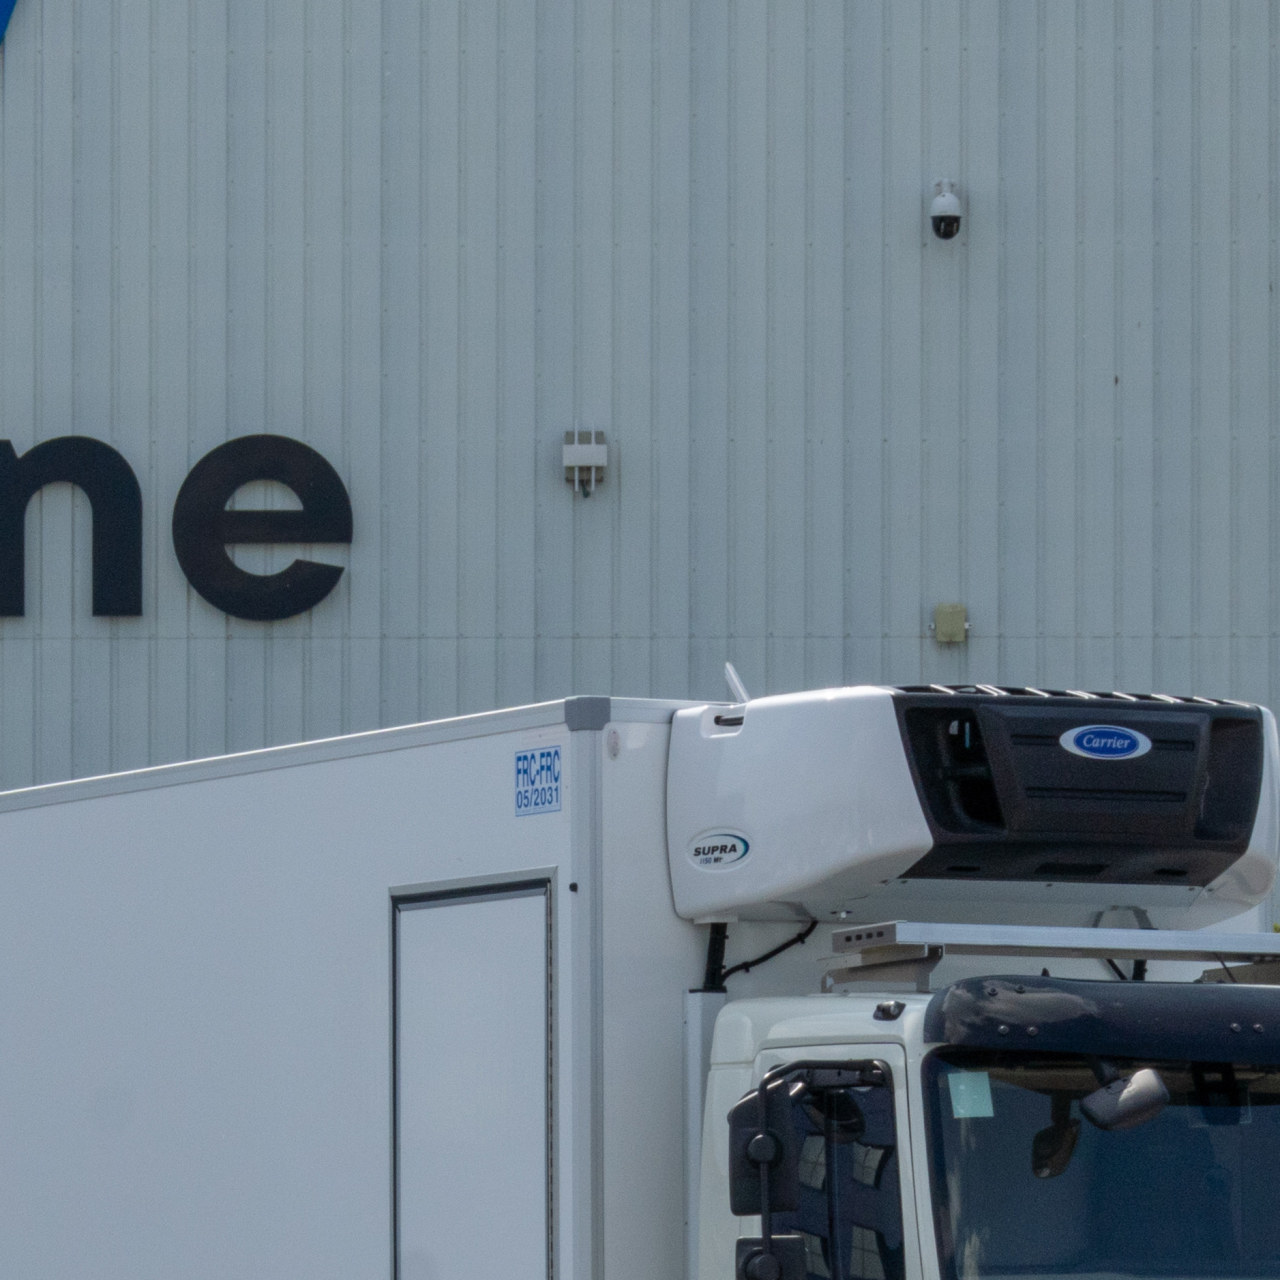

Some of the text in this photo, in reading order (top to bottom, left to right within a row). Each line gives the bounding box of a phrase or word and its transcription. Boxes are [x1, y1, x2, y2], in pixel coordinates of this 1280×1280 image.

[1083, 734, 1131, 749] Carrier
[516, 749, 560, 788] FRC-FRC
[517, 785, 559, 809] 05/2031
[693, 843, 737, 857] SUPRA
